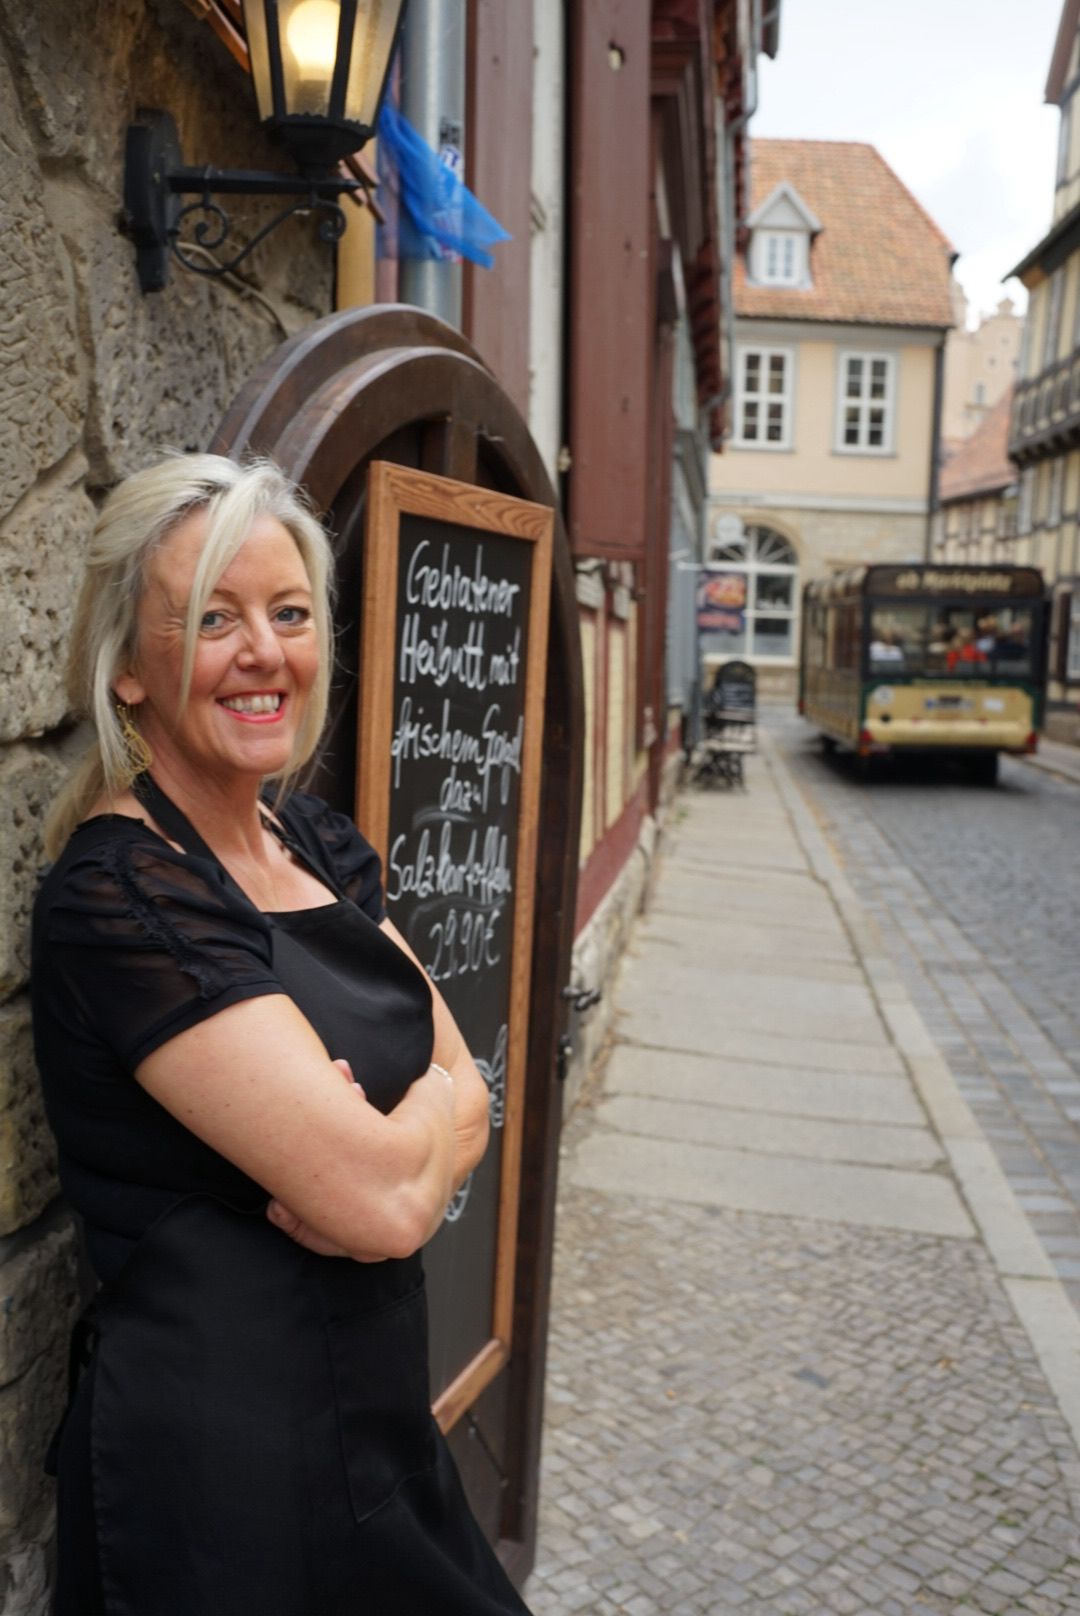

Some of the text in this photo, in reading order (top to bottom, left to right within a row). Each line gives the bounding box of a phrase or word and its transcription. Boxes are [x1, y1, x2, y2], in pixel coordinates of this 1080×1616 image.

[406, 540, 520, 618] Gebratener
[400, 612, 521, 691] Heilbutt mit
[391, 697, 485, 789] frischem
